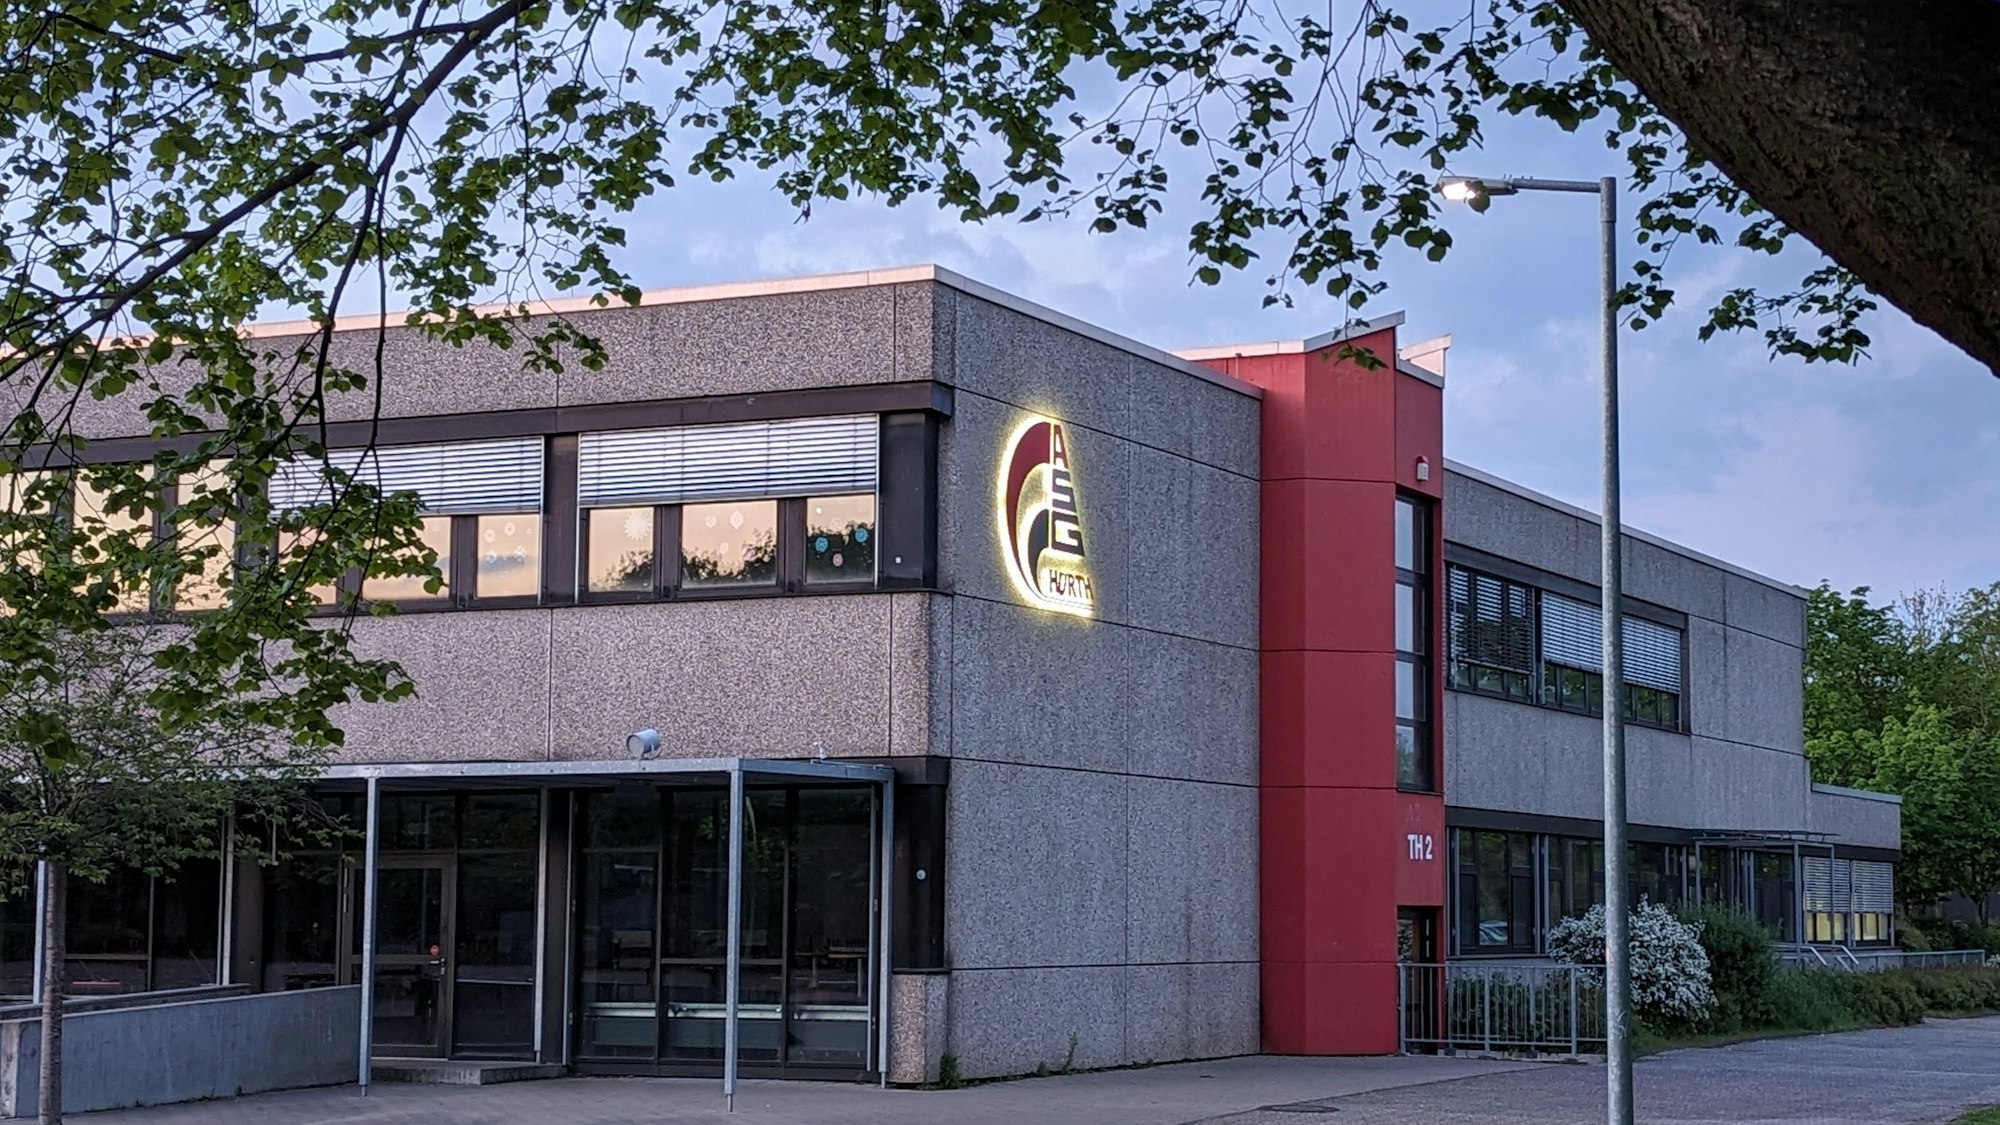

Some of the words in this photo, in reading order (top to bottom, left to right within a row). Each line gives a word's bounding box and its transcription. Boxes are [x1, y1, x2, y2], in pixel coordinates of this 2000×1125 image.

[1051, 424, 1086, 557] ASG
[1407, 834, 1423, 860] TH
[1425, 835, 1433, 860] 2
